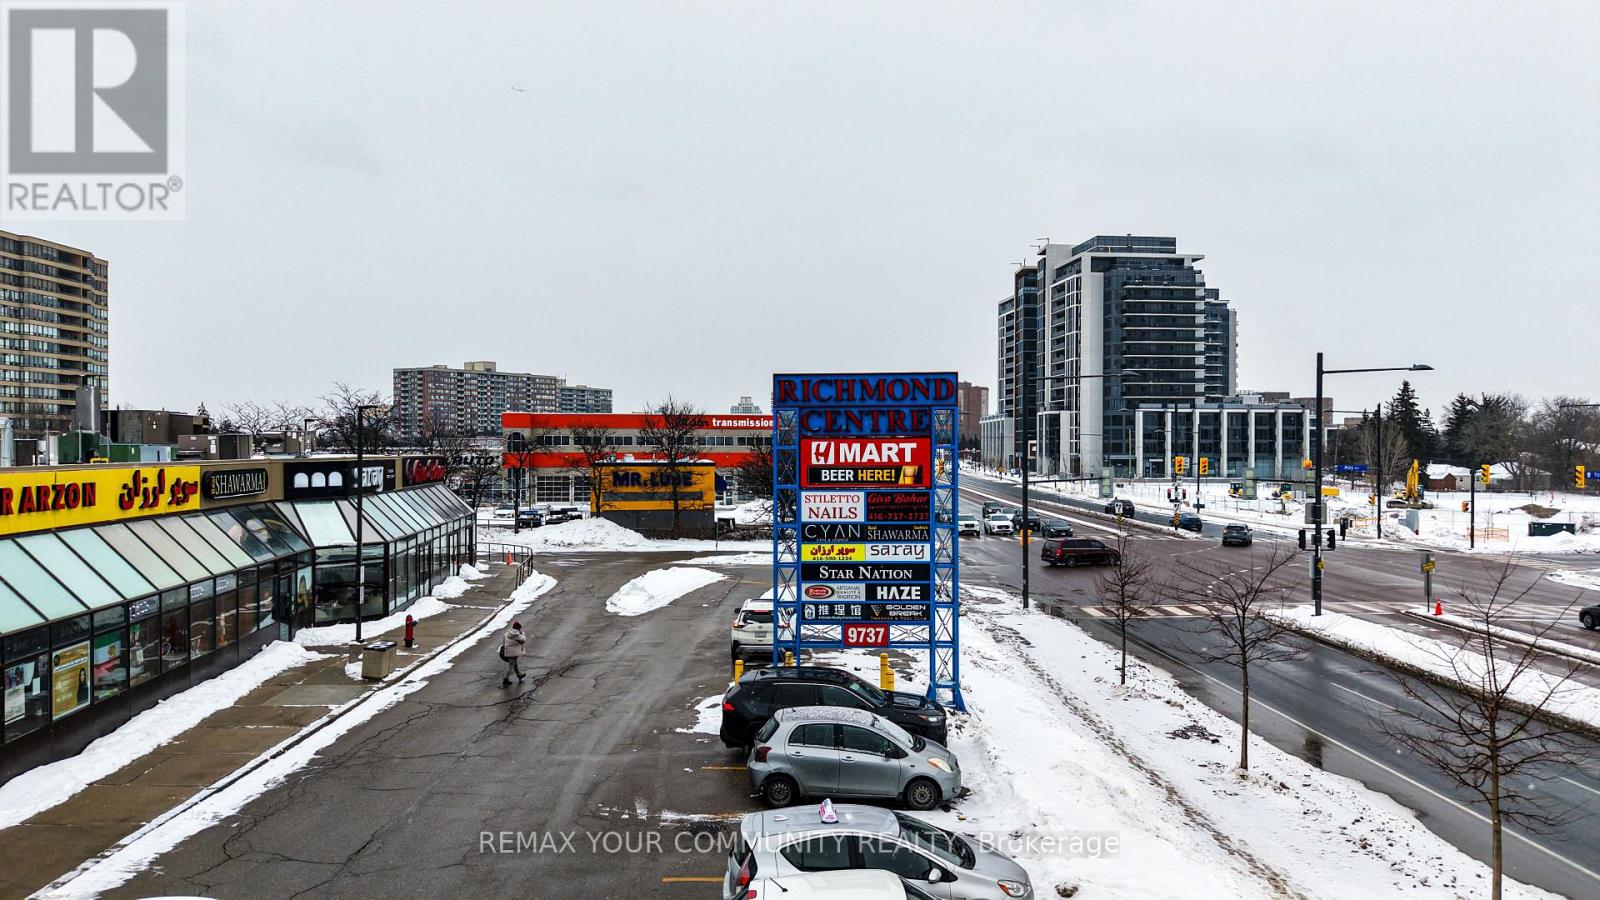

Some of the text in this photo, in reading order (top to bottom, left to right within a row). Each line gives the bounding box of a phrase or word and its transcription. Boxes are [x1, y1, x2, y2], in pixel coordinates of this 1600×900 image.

[777, 378, 956, 402] RICHMOND
[801, 408, 931, 433] CENTRE
[839, 442, 917, 463] MART
[821, 469, 895, 481] BEER HERE!
[215, 473, 263, 495] SHAWARMA
[18, 482, 96, 514] ARZON
[804, 494, 860, 503] STILETTO
[808, 507, 858, 519] NAILS
[804, 524, 861, 538] CYAN
[867, 530, 929, 540] SHAWARMA
[870, 545, 925, 559] saray
[876, 586, 921, 600] HAZE
[847, 627, 885, 643] 9737
